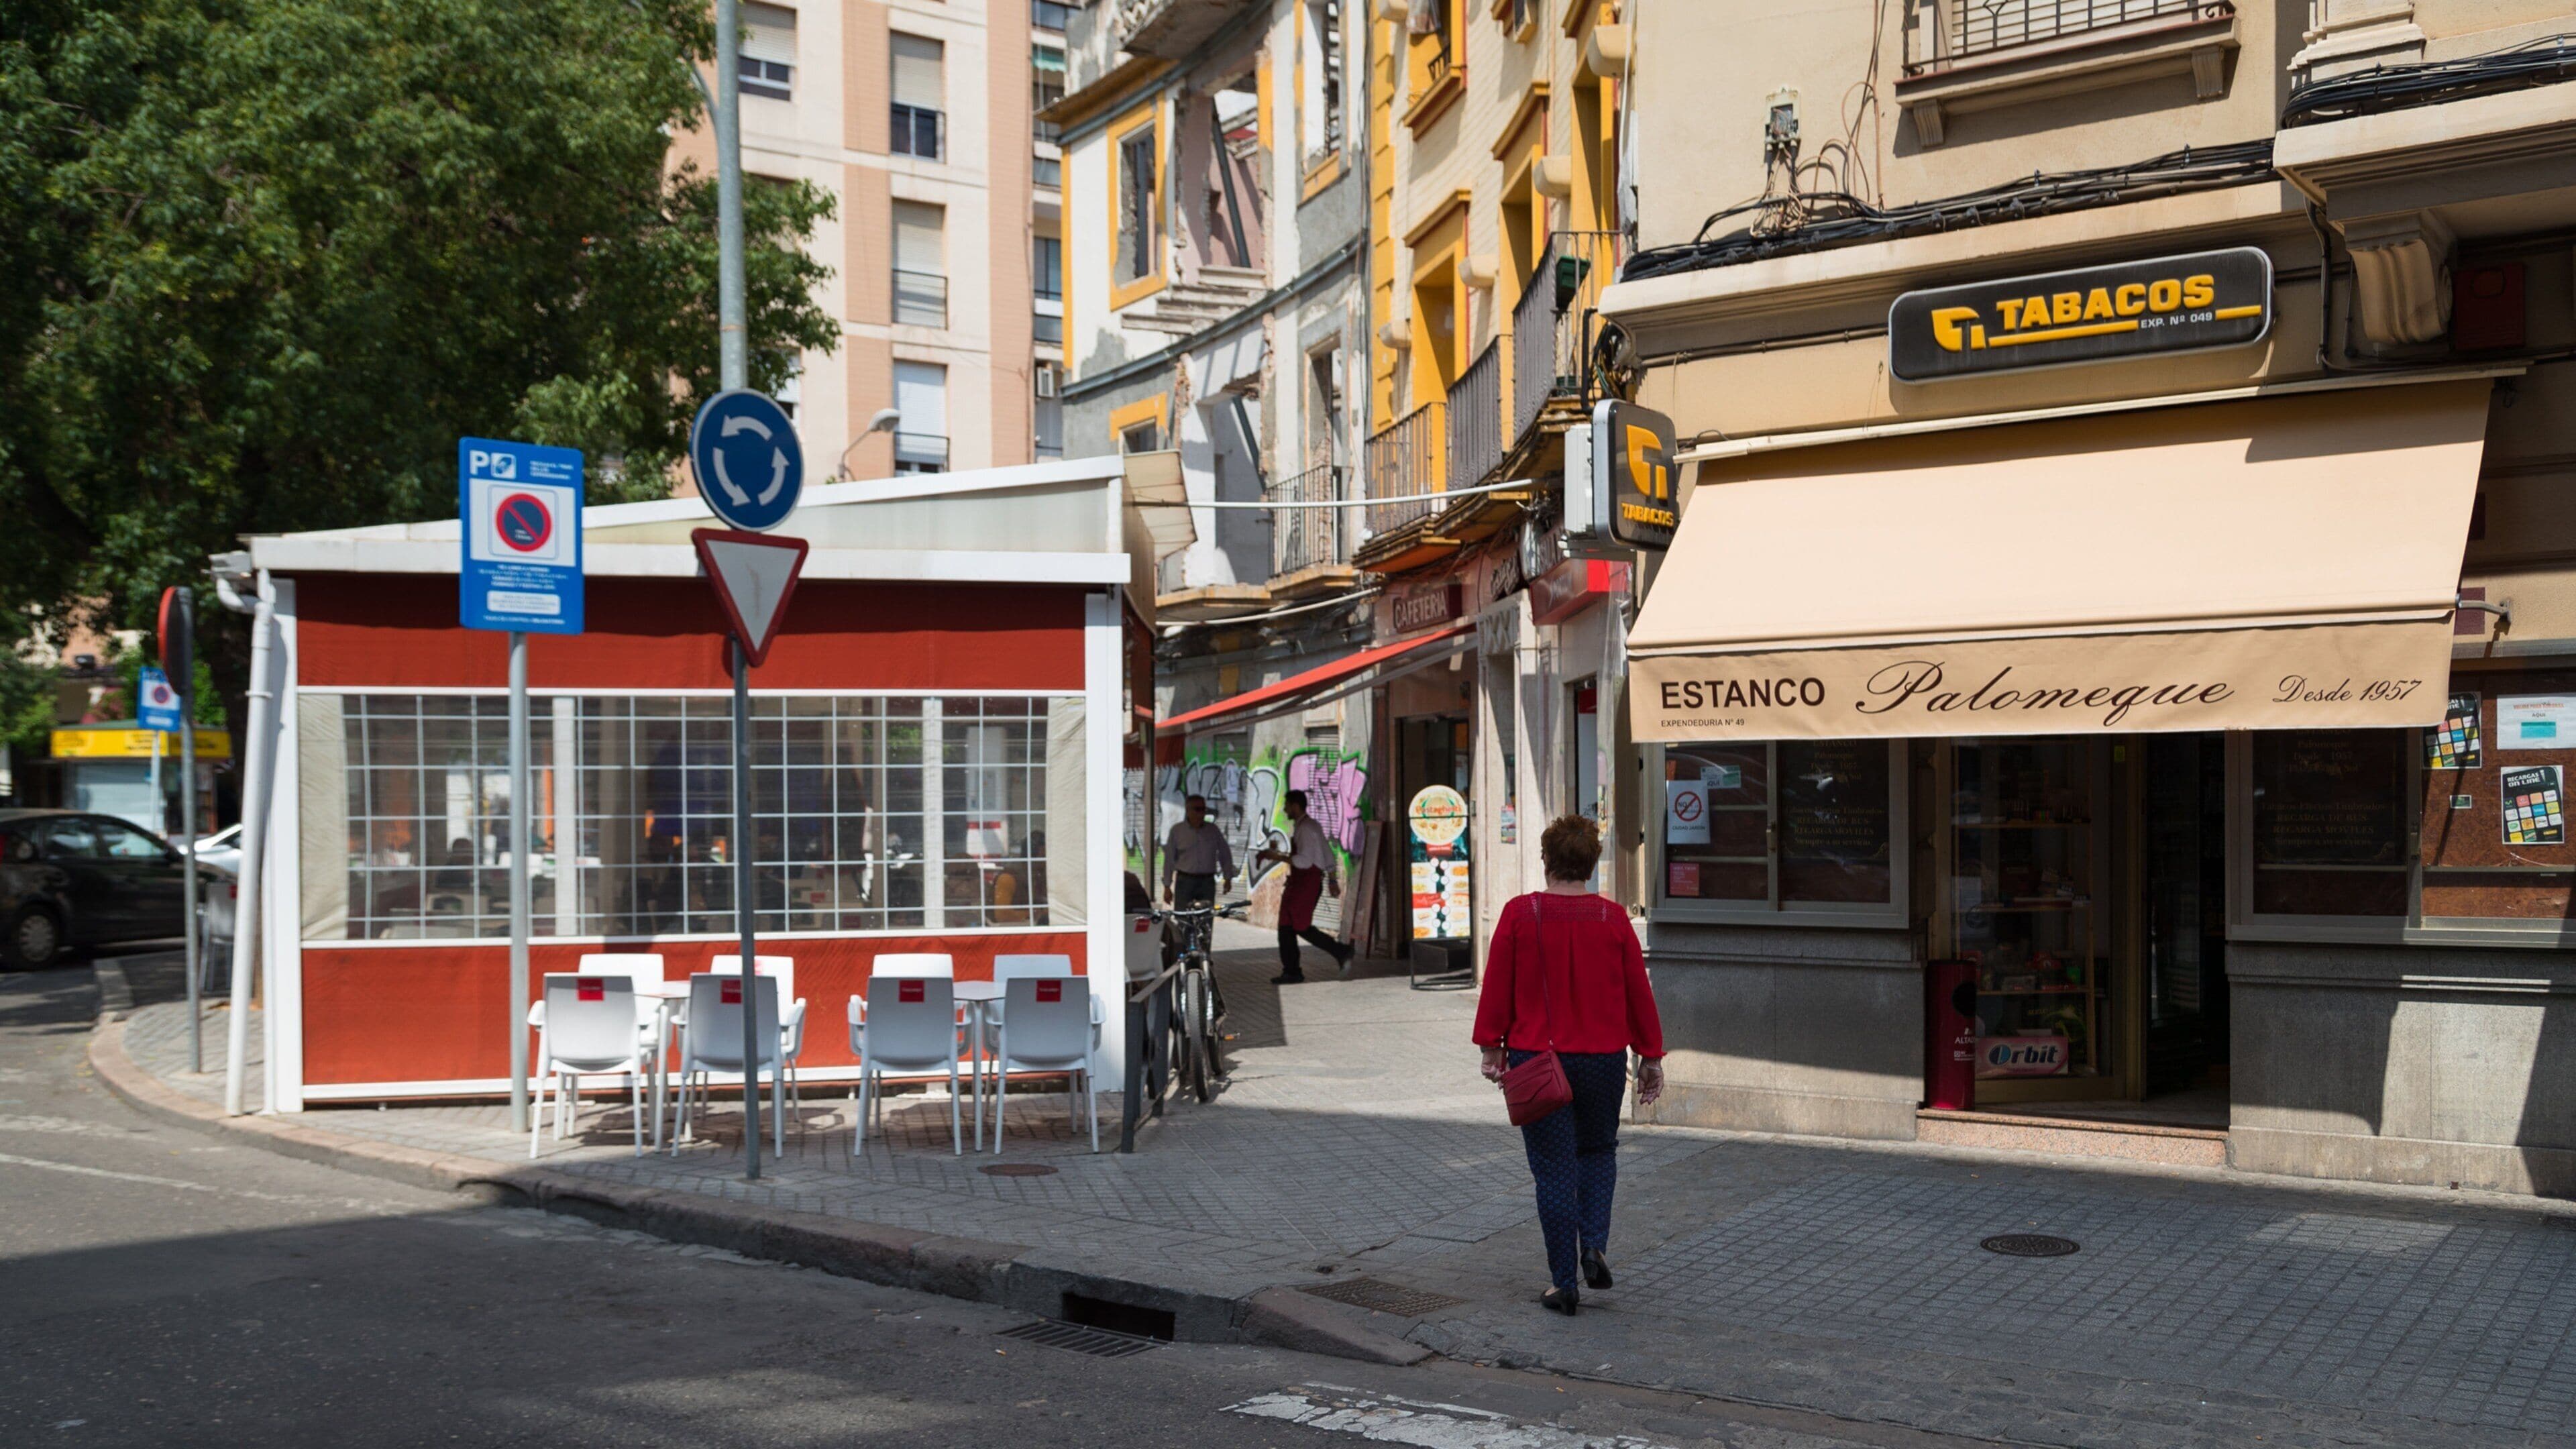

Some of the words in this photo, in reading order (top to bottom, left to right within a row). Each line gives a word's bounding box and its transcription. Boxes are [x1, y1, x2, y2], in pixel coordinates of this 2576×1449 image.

[1996, 274, 2214, 330] TABACOS
[2141, 317, 2165, 329] EXP.
[2190, 312, 2212, 323] 049
[470, 449, 490, 476] P
[1621, 502, 1674, 528] TABACOS
[1395, 590, 1447, 629] CAFETERIA
[1661, 677, 1825, 709] ESTANCO
[1856, 661, 2235, 726] Palomeque
[2272, 675, 2353, 702] Desde
[2359, 679, 2421, 702] 1957
[1661, 719, 1723, 727] EXPENDEDURIA
[1736, 718, 1744, 727] 49
[2507, 772, 2539, 782] RECARGAS
[1989, 1044, 2058, 1065] Orbit
